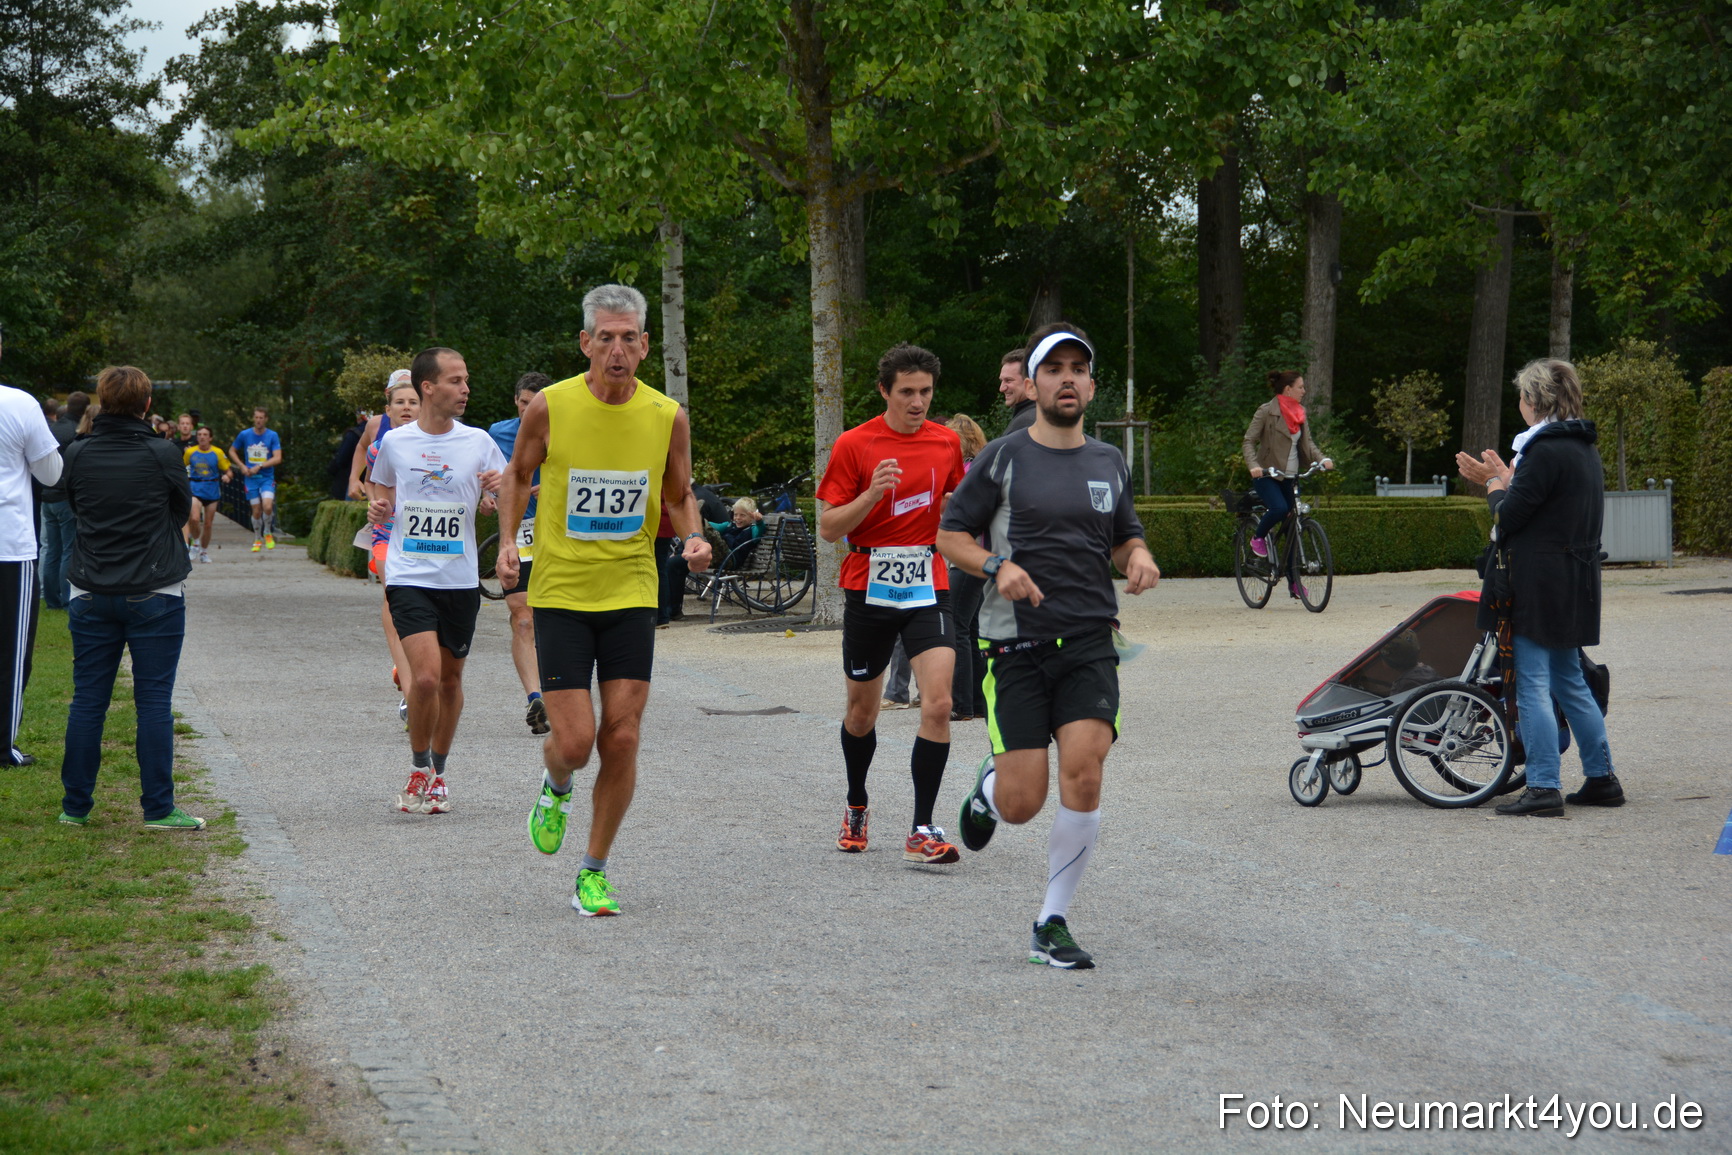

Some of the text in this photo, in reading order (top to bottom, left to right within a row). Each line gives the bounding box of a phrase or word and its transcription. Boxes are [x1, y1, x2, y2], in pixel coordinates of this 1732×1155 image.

[571, 476, 597, 484] PARTL
[576, 487, 642, 514] 2137
[409, 515, 459, 538] 2446
[590, 520, 623, 530] Rudolf
[416, 542, 449, 552] Michael
[877, 560, 926, 584] 2334
